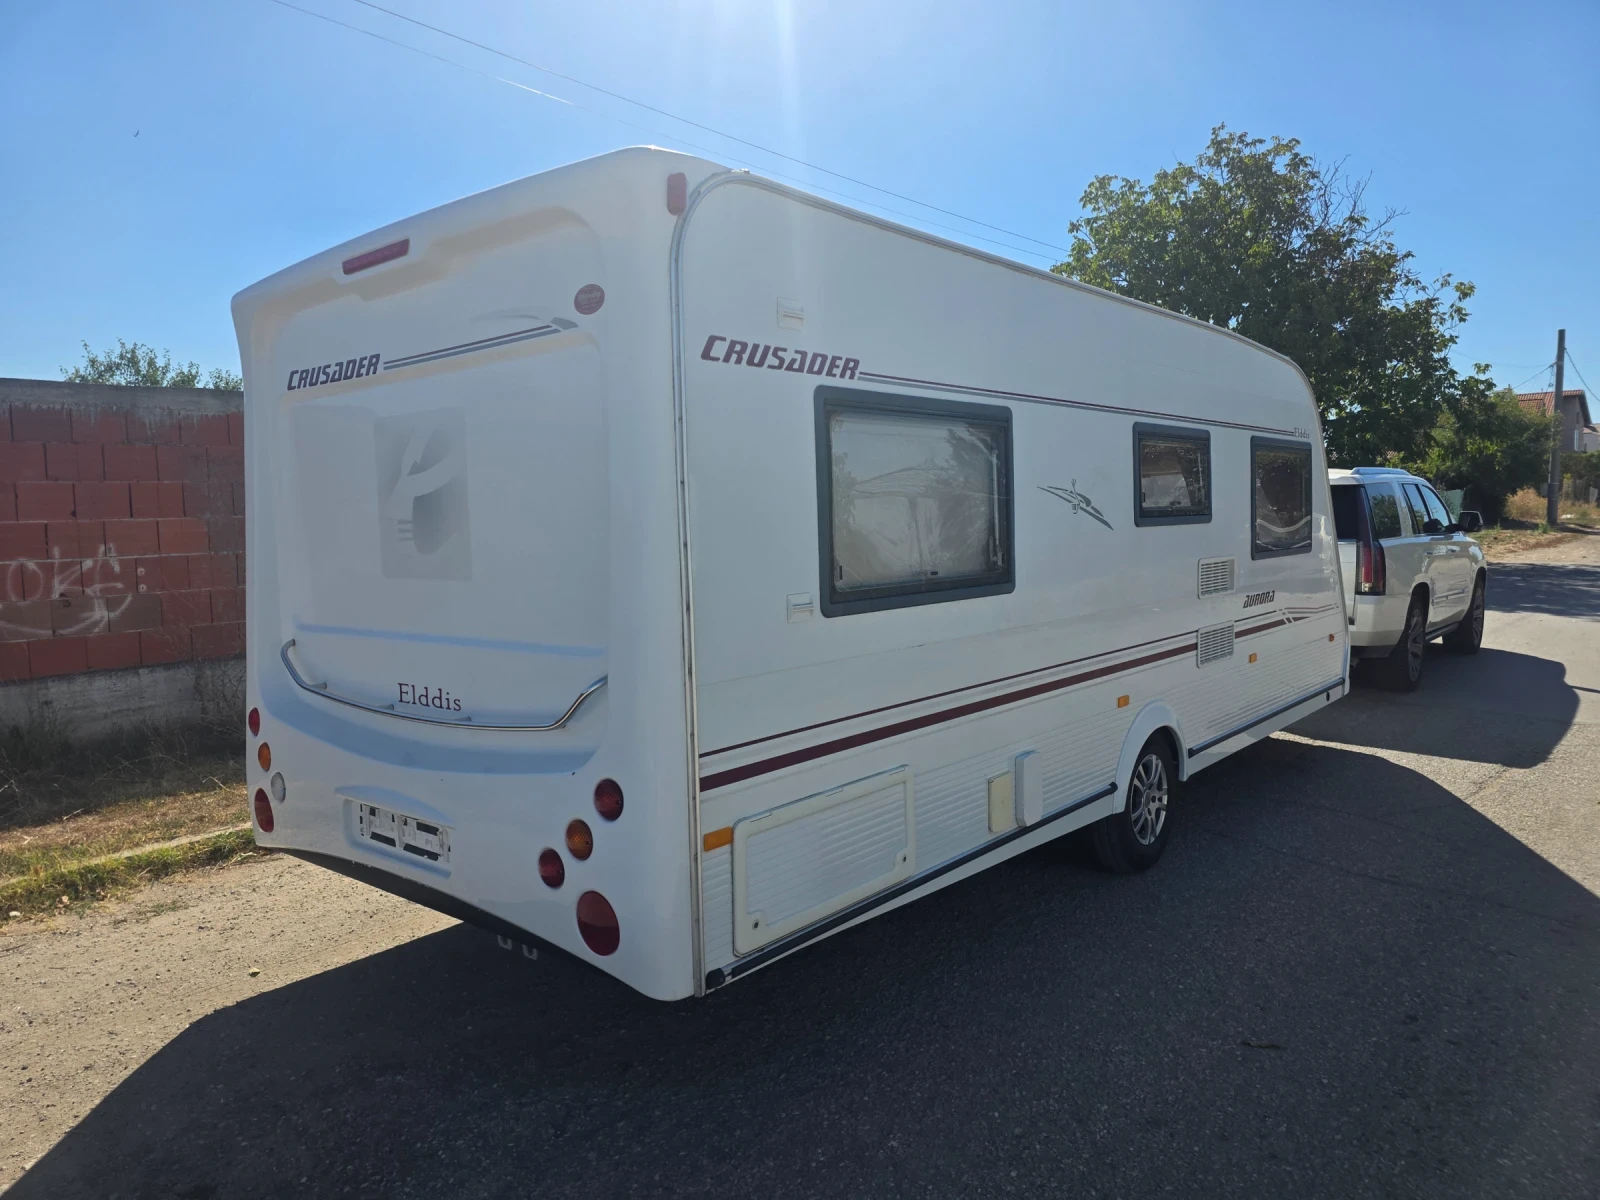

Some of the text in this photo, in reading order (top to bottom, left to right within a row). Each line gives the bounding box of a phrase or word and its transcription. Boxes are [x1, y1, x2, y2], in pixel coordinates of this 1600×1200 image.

[286, 353, 381, 391] CRUSADER
[700, 334, 860, 380] CRUSADER
[397, 682, 462, 712] Elddis
